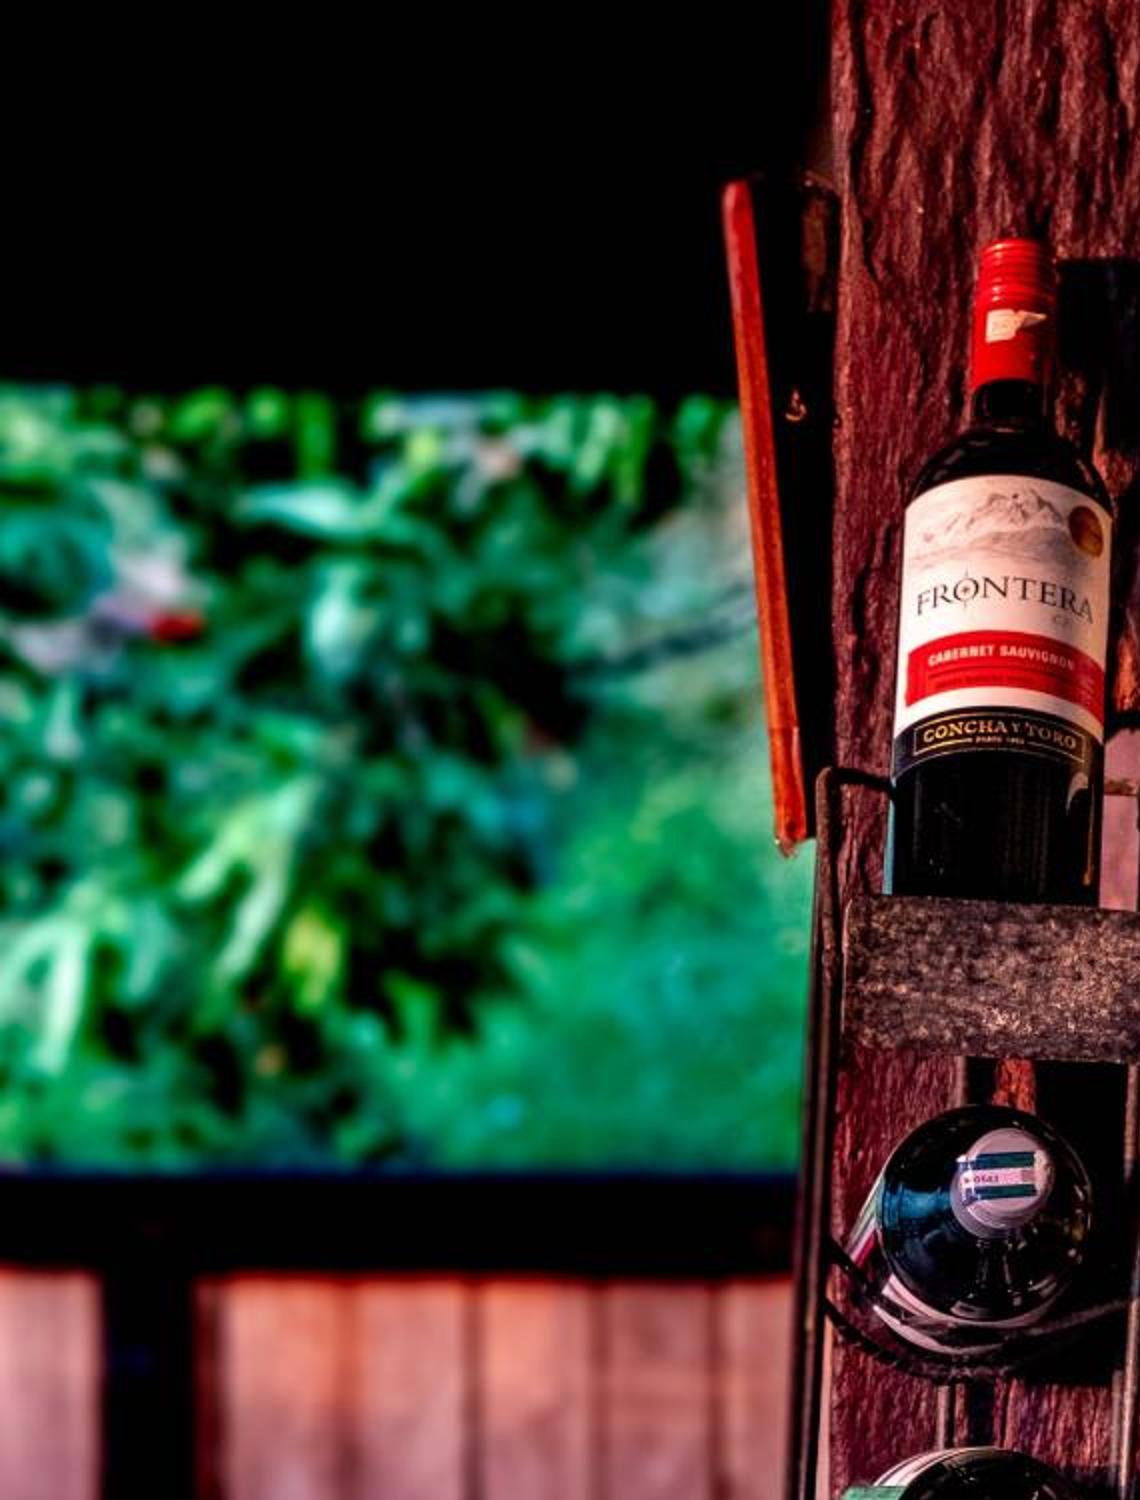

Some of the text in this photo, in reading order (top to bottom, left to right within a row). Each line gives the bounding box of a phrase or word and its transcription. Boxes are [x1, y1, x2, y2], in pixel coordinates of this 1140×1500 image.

[917, 574, 1094, 625] FRONTERA
[928, 644, 1076, 671] CABERNET SAUVIGNON
[922, 720, 1007, 743] CONCHA
[1023, 721, 1077, 749] TORO
